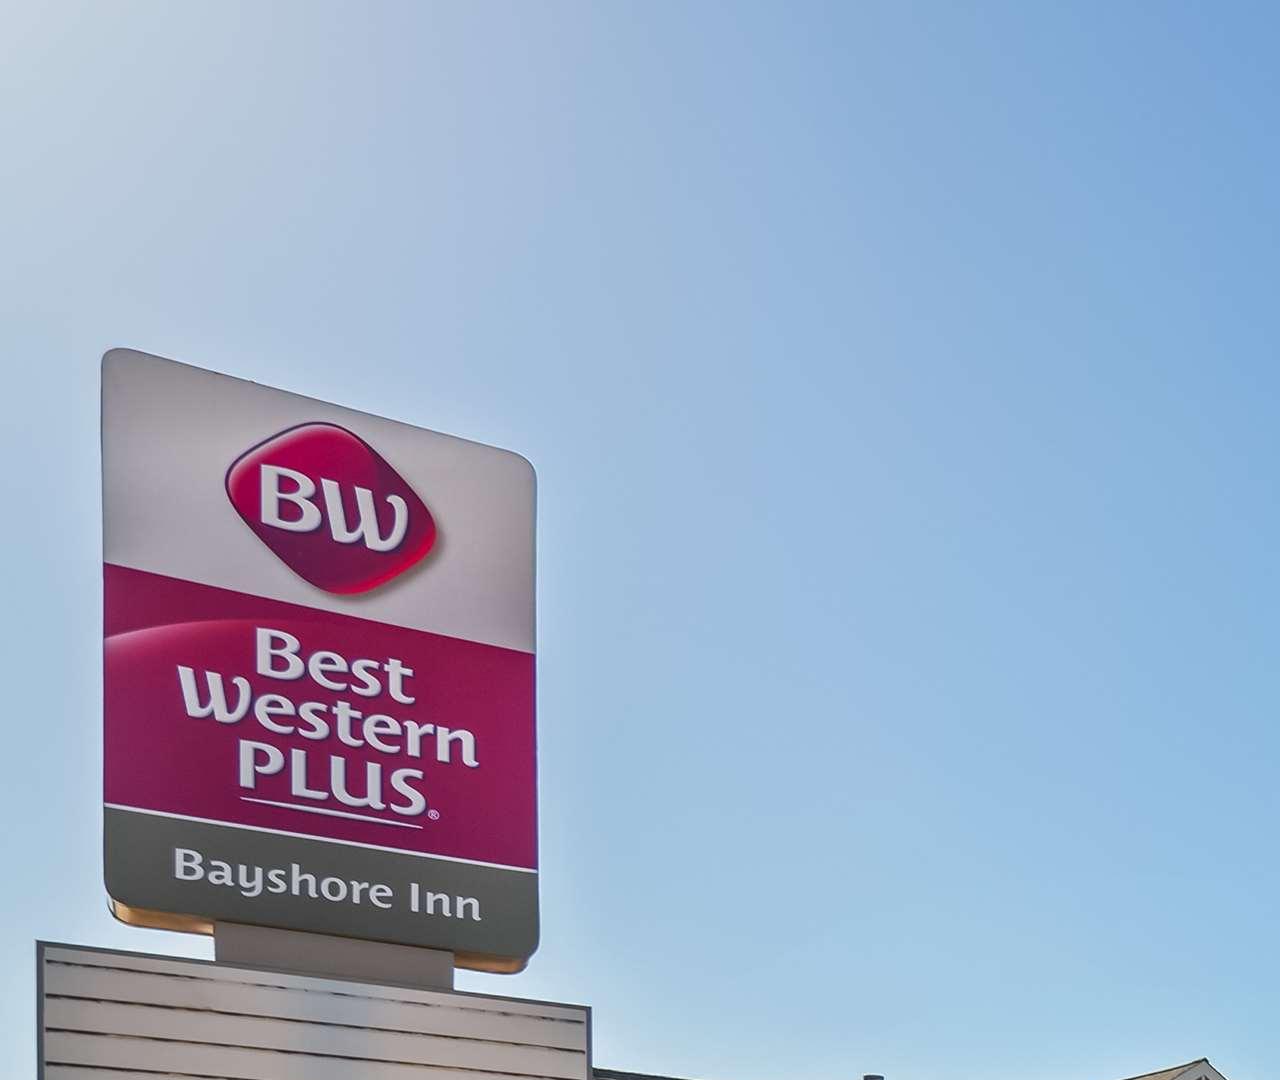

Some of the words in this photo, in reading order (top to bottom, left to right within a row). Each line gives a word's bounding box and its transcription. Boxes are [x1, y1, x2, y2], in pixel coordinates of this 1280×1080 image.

[260, 463, 409, 553] BW
[256, 626, 416, 705] Best
[178, 664, 480, 768] Western
[174, 847, 393, 909] Bayshore
[410, 881, 482, 922] Inn
